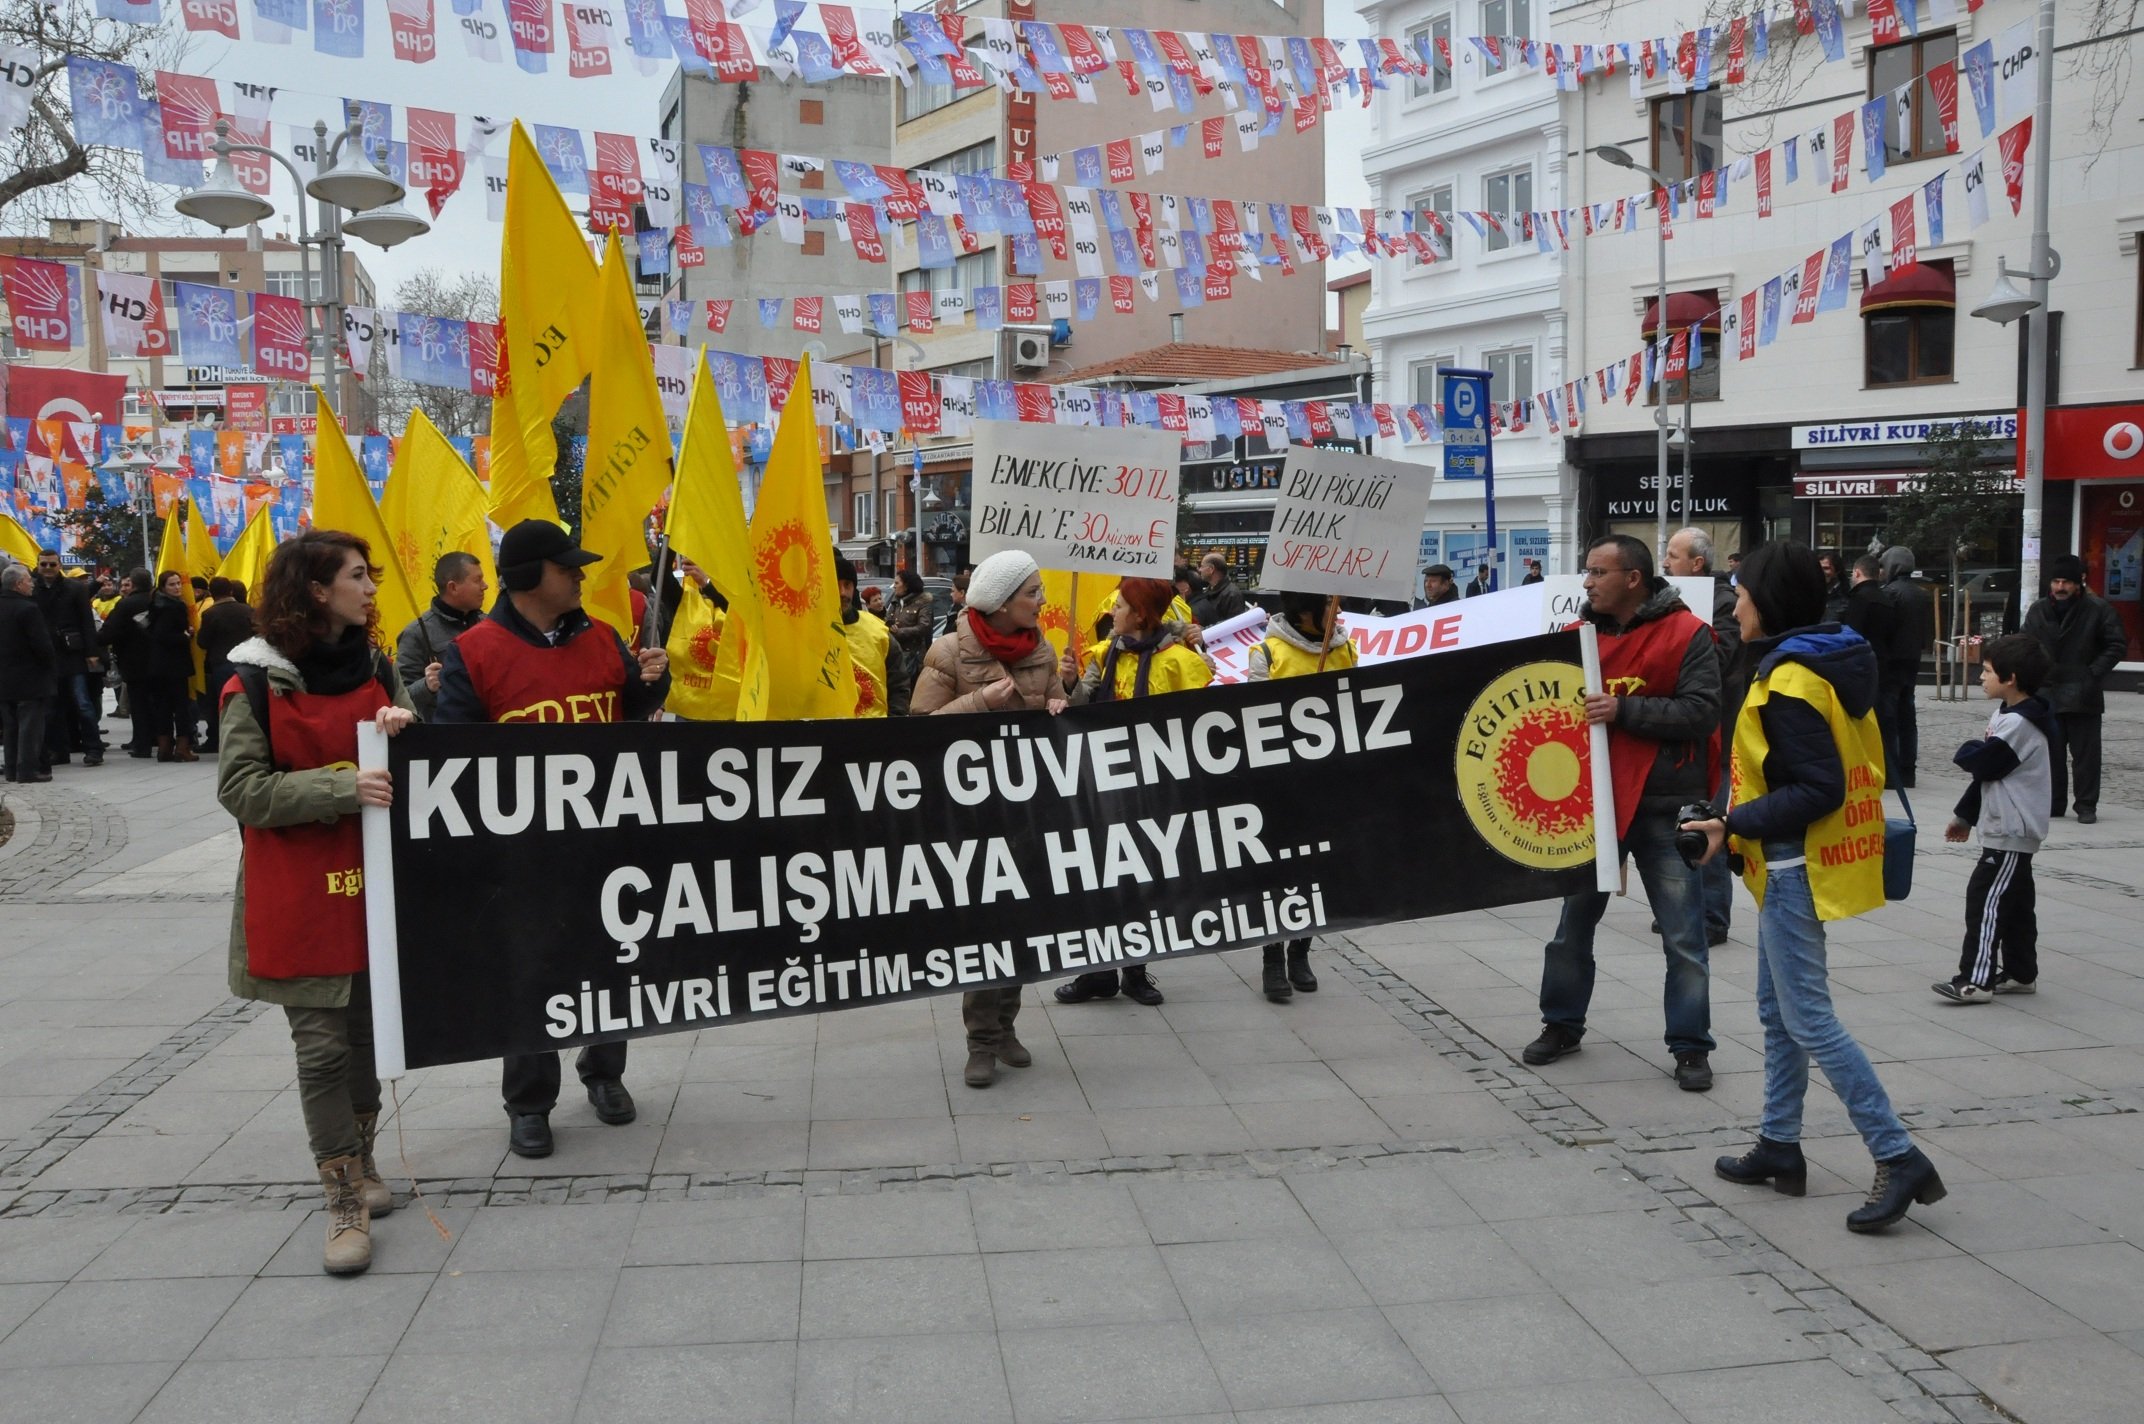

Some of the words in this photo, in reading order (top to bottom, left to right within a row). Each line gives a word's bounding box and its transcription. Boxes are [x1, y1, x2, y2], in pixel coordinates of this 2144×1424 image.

[2003, 46, 2032, 80] CHP
[1891, 245, 1915, 272] CHP
[1808, 423, 1881, 444] SİLİVRİ
[990, 454, 1107, 494] EMEKÇİYE
[1107, 465, 1143, 498] 30
[1212, 459, 1280, 491] UĞUR
[1286, 468, 1323, 501] BU
[1322, 473, 1397, 511] PİSLİĞİ
[1805, 479, 1875, 496] SİLİVRİ
[1074, 512, 1109, 544] 30
[1278, 507, 1347, 541] HALK
[1112, 547, 1158, 565] ÜSTÜ
[1466, 678, 1561, 762] EĞİTİM
[409, 746, 826, 840] KURALSIZ
[845, 759, 922, 812] ve
[943, 677, 1412, 807] GÜVENCESİZ
[1476, 782, 1498, 824] Eğitim
[1512, 835, 1543, 855] Bilim
[601, 836, 1031, 964] ÇALIŞMAYA
[1044, 802, 1332, 896] HAYIR...
[545, 965, 732, 1040] SİLİVRİ
[748, 940, 1016, 1013] EĞİTİM-SEN
[1027, 883, 1328, 973] TEMSİLCİLİĞİ
